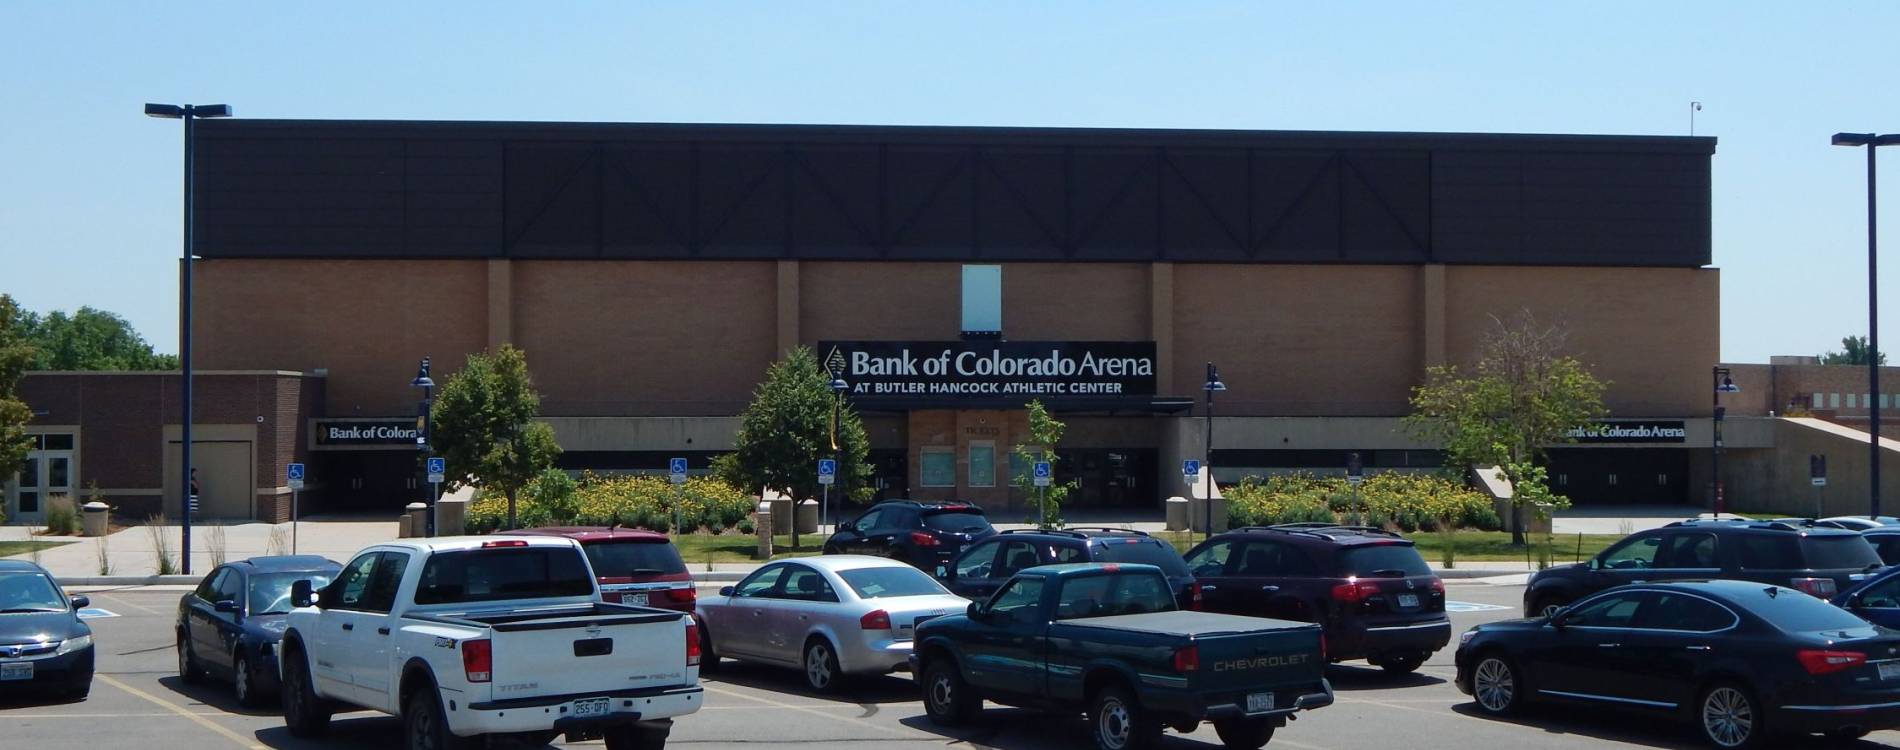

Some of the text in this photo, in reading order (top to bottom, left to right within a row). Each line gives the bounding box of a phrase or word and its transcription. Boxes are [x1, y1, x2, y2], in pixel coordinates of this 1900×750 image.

[852, 349, 1153, 376] Bank of Colorado Arena
[854, 382, 1122, 393] AT BUTLER HANCOCK ATHLETIC CENTER
[330, 426, 417, 439] Bank of Colora
[1600, 425, 1650, 437] Colorado
[1651, 425, 1684, 437] Arena
[1214, 654, 1309, 672] CHEVROLET
